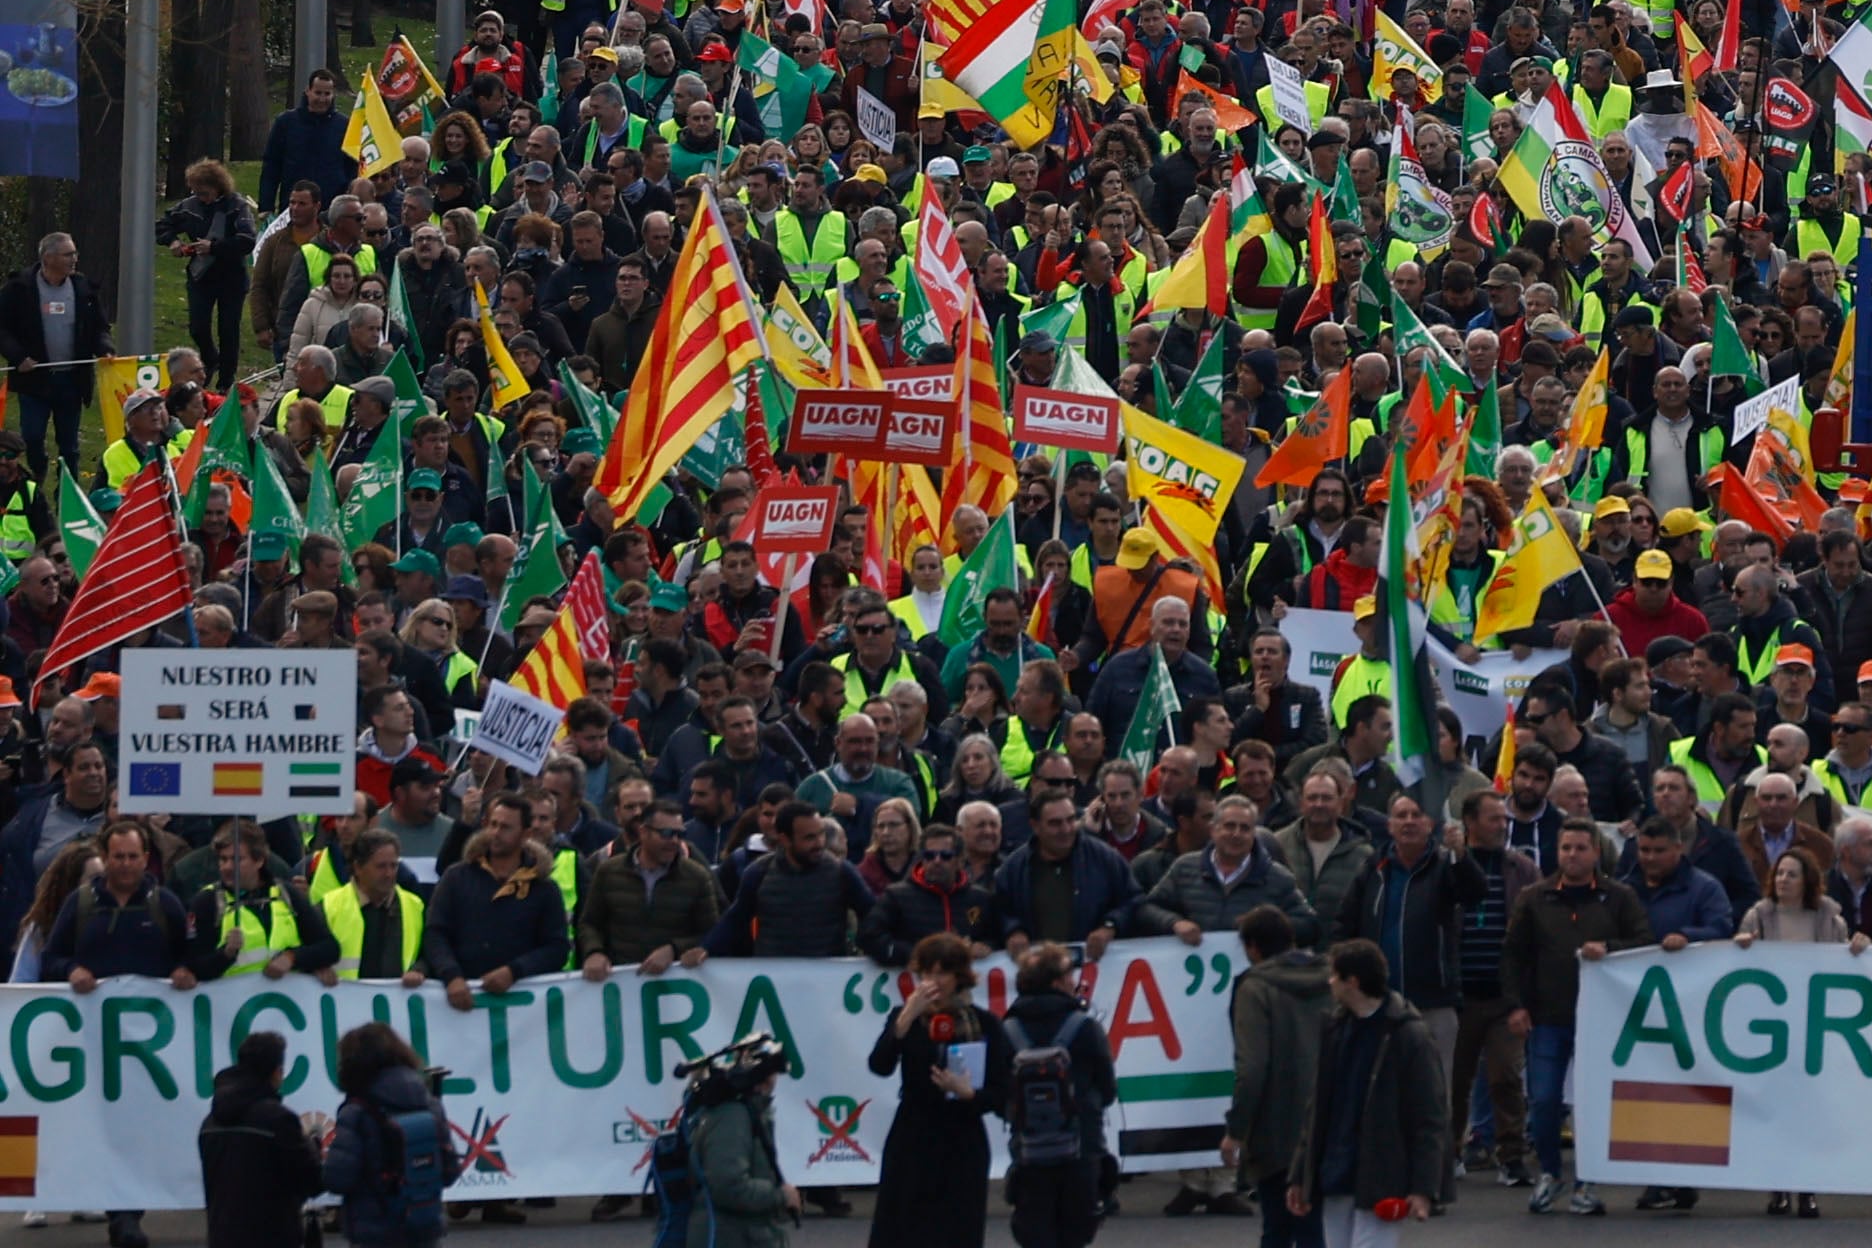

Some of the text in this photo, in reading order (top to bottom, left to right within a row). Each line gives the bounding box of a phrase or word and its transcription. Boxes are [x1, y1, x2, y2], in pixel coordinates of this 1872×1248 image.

[1564, 144, 1601, 166] CAMPO
[806, 403, 882, 427] UAGN
[1028, 398, 1105, 426] UAGN
[886, 415, 942, 437] AGN
[767, 500, 825, 523] UAGN
[161, 666, 317, 687] NUESTRO FIN
[208, 695, 270, 720] SERÁ
[480, 694, 560, 756] ¡JUSTICIA!
[131, 733, 345, 753] VUESTRA HAMBRE
[0, 975, 803, 1103] GRICULTURA
